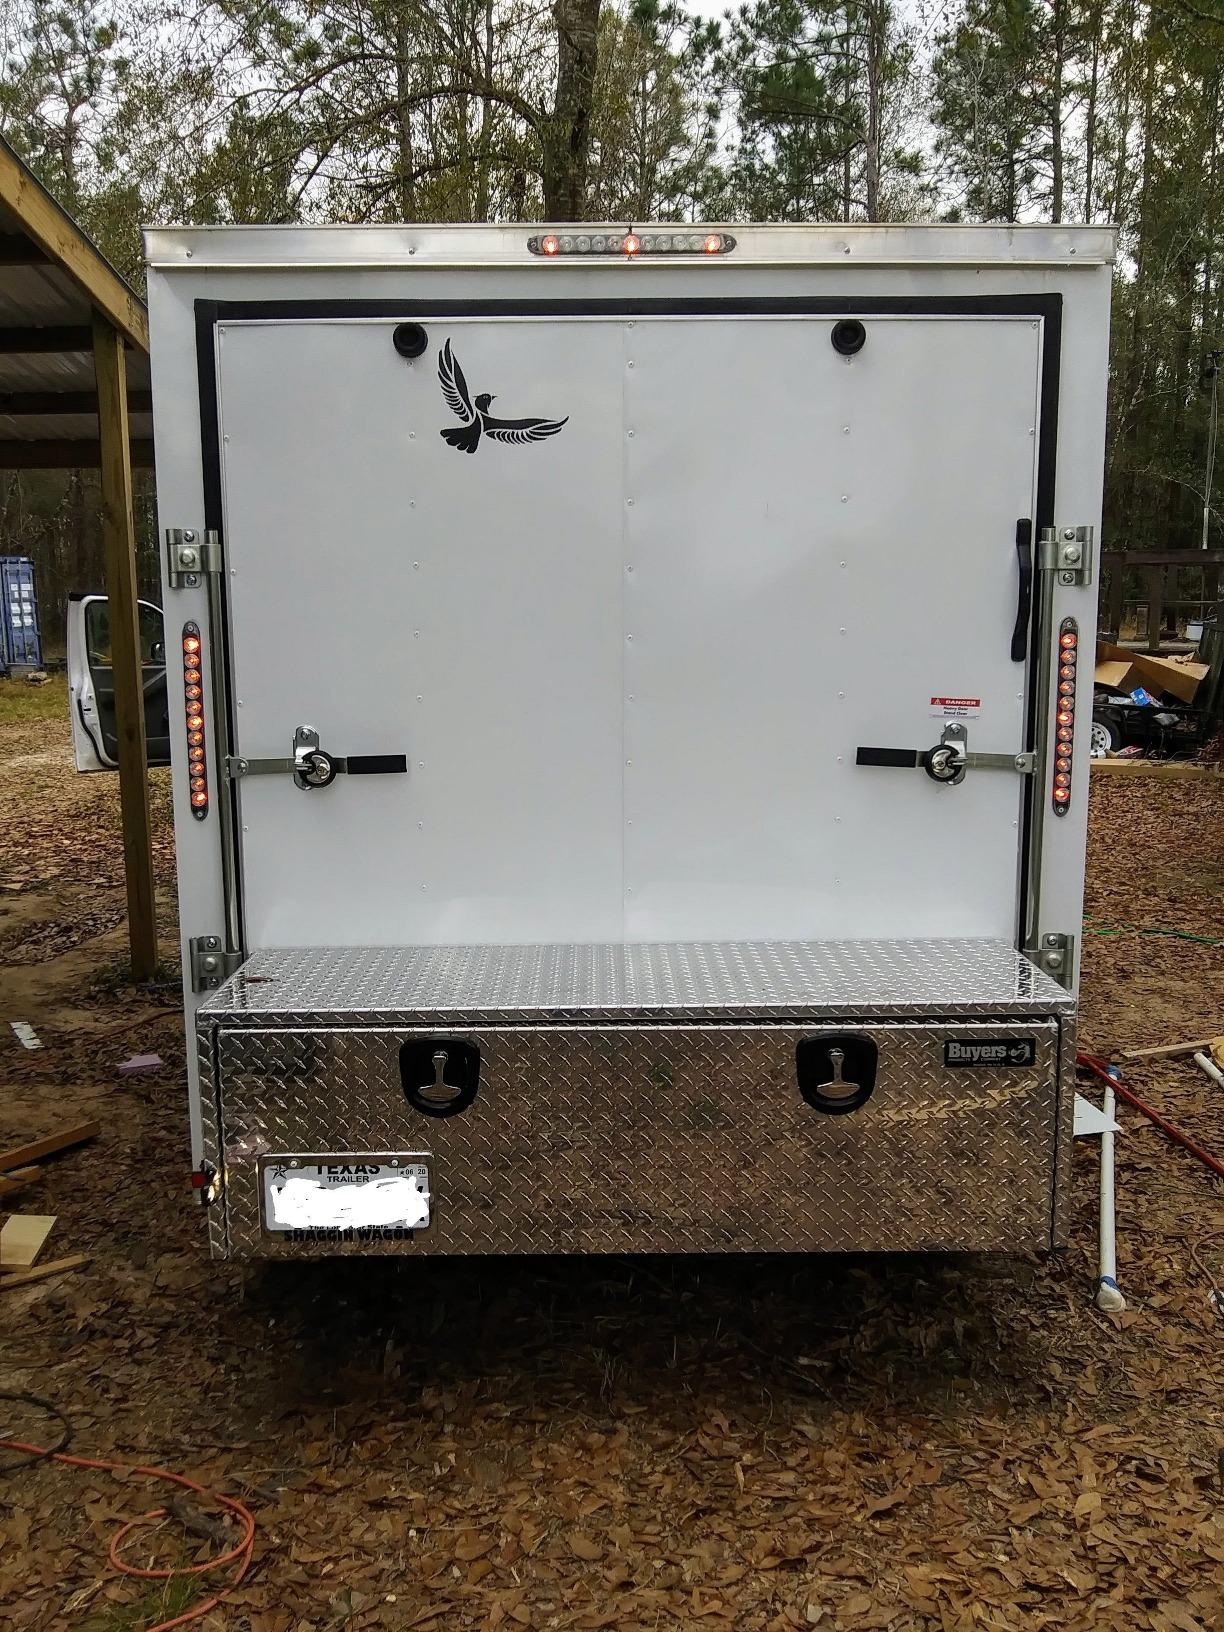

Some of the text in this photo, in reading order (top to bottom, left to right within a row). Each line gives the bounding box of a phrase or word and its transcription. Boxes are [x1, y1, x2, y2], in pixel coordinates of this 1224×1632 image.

[948, 1042, 1007, 1061] Buyers
[317, 1165, 381, 1175] TEXAS
[284, 1229, 415, 1242] SHAGGIN WAGON
